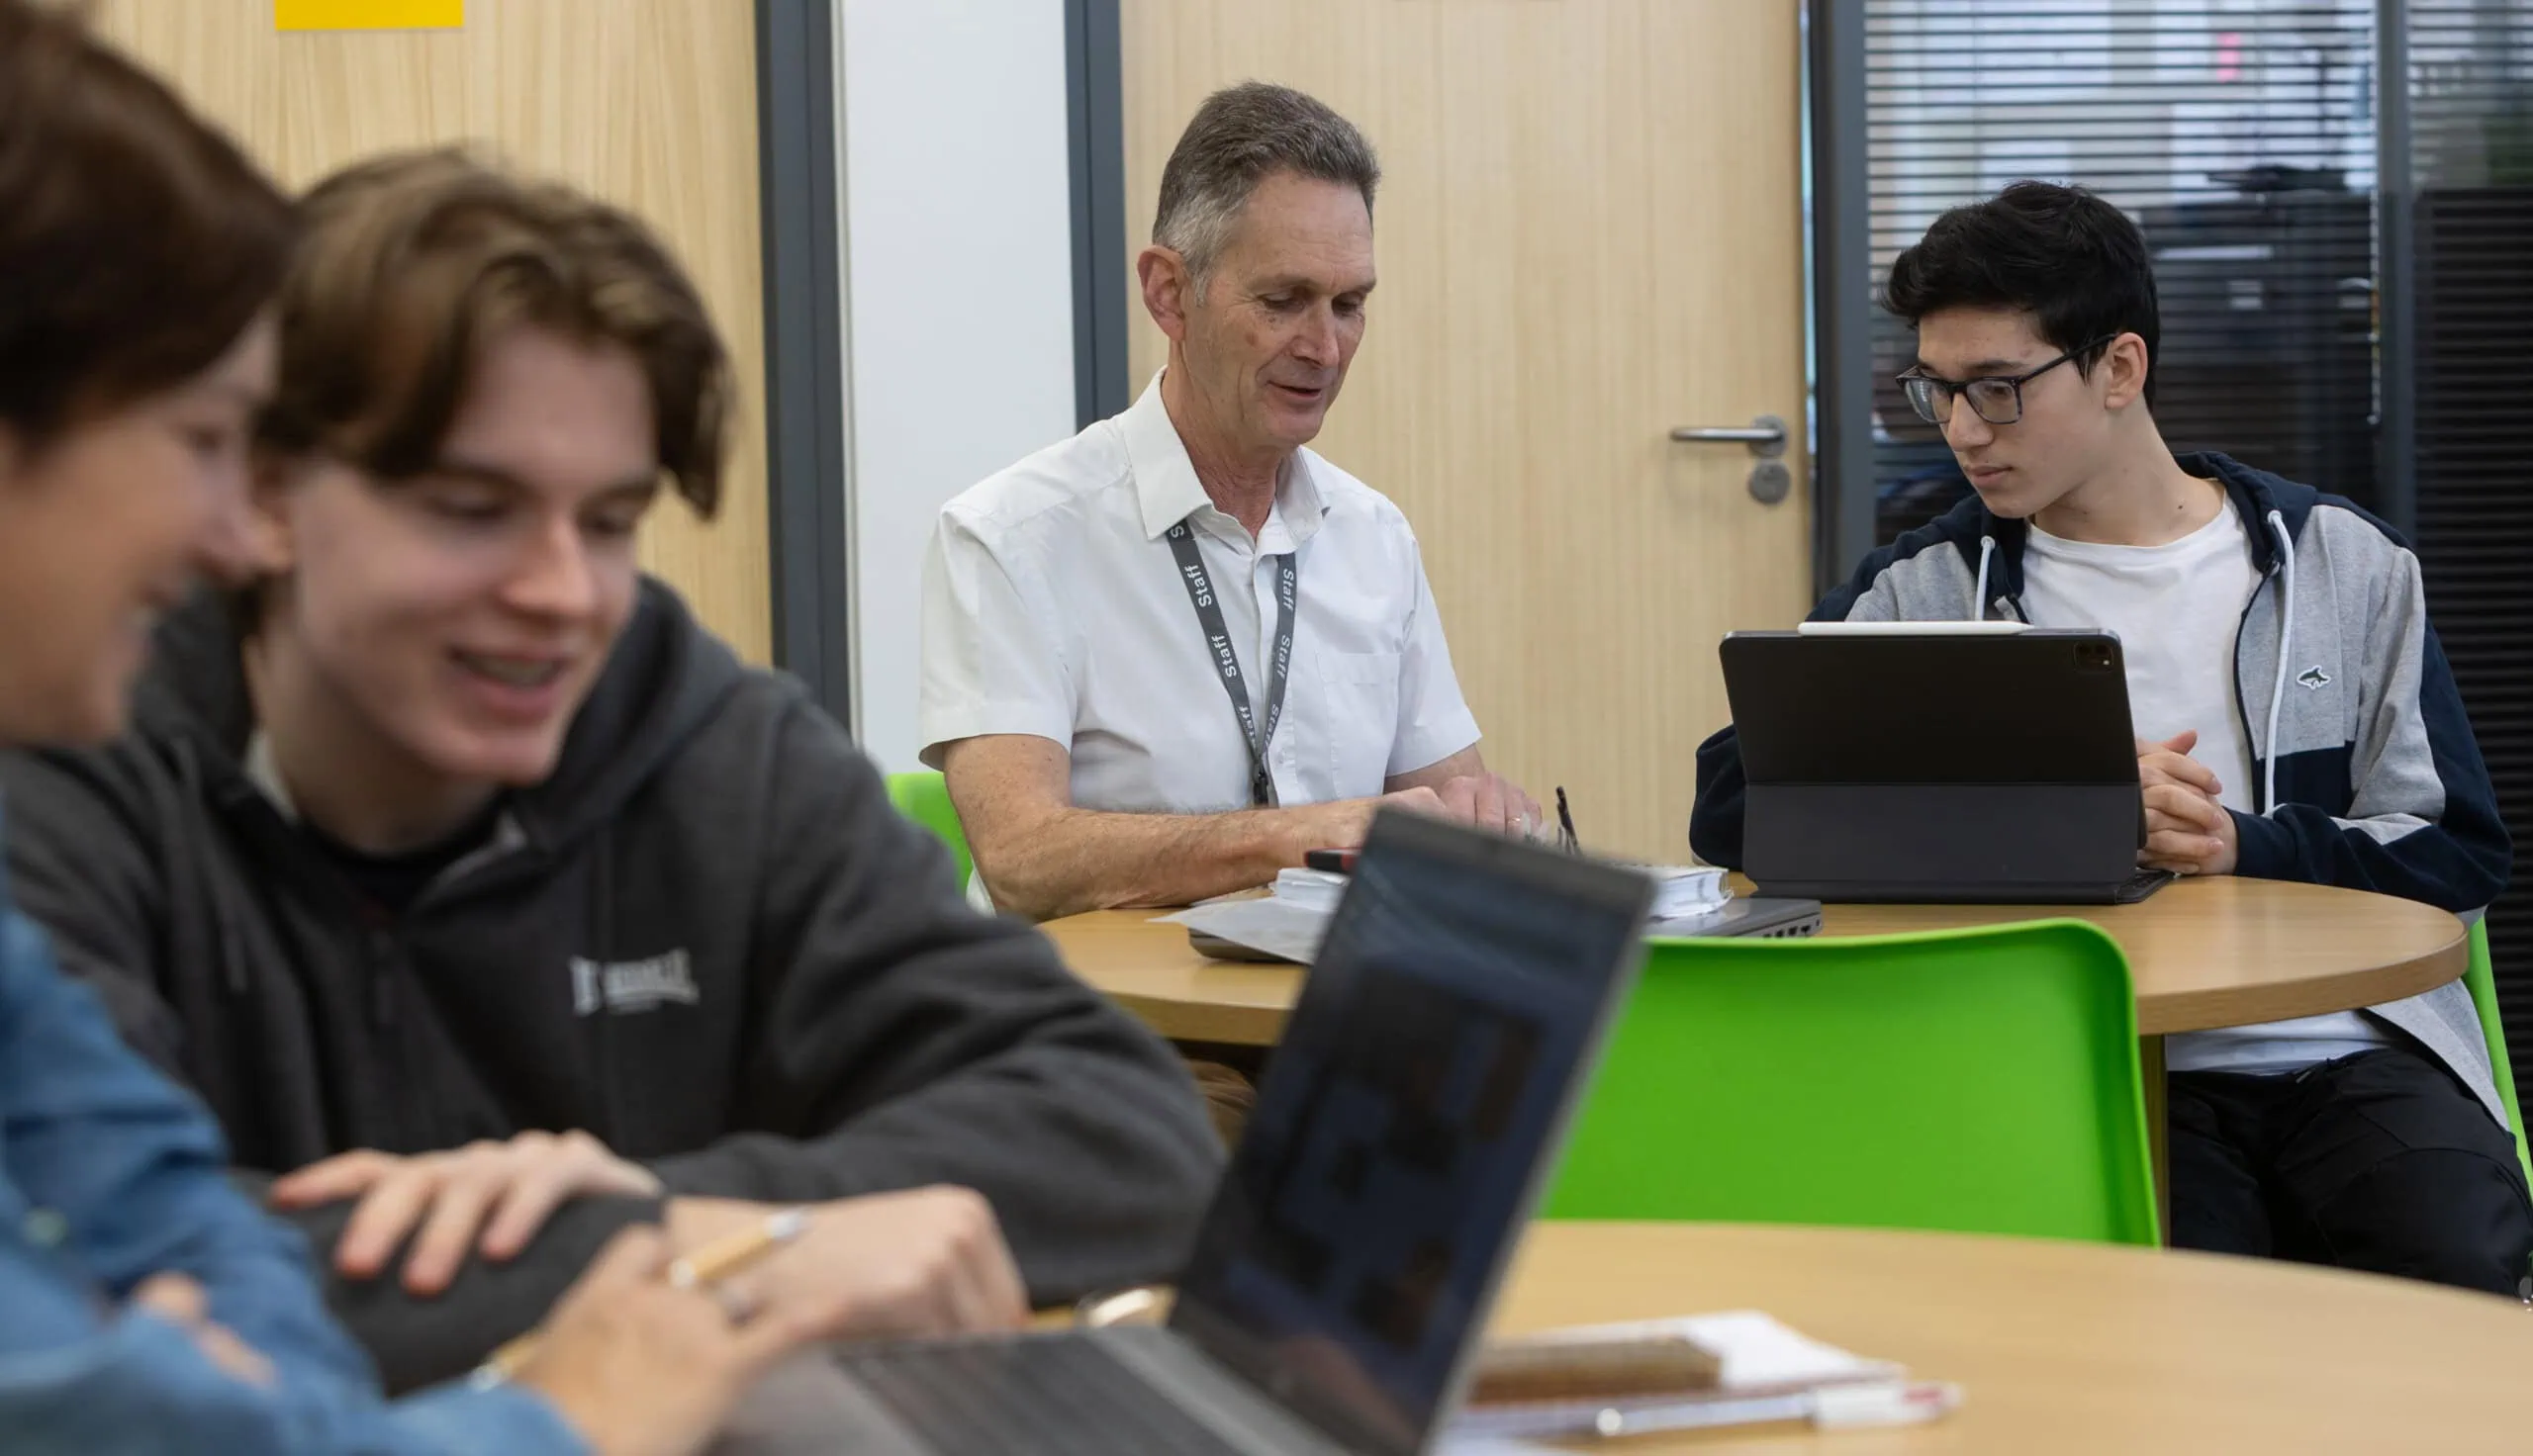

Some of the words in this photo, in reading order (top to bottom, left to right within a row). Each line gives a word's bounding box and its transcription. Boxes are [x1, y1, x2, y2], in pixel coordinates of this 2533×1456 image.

[1184, 564, 1212, 607] Staff
[1282, 568, 1294, 611] Staff
[1211, 634, 1237, 678] Staff
[1276, 634, 1290, 681] Staff
